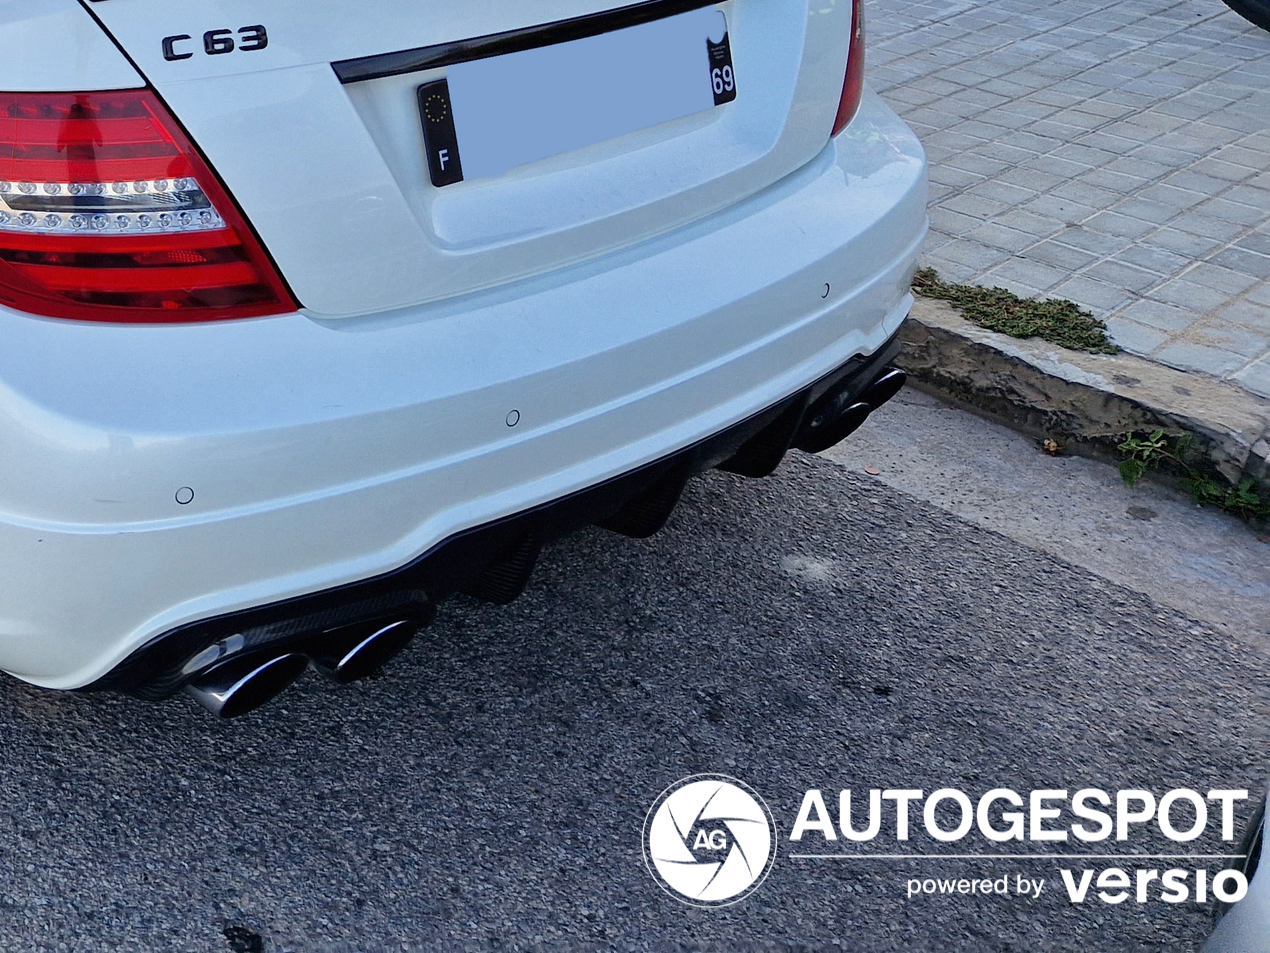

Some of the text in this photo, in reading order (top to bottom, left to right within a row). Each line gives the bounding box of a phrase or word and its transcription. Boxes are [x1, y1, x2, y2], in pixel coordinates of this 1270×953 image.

[162, 24, 269, 62] C 63
[712, 64, 734, 95] 69
[438, 149, 449, 171] F
